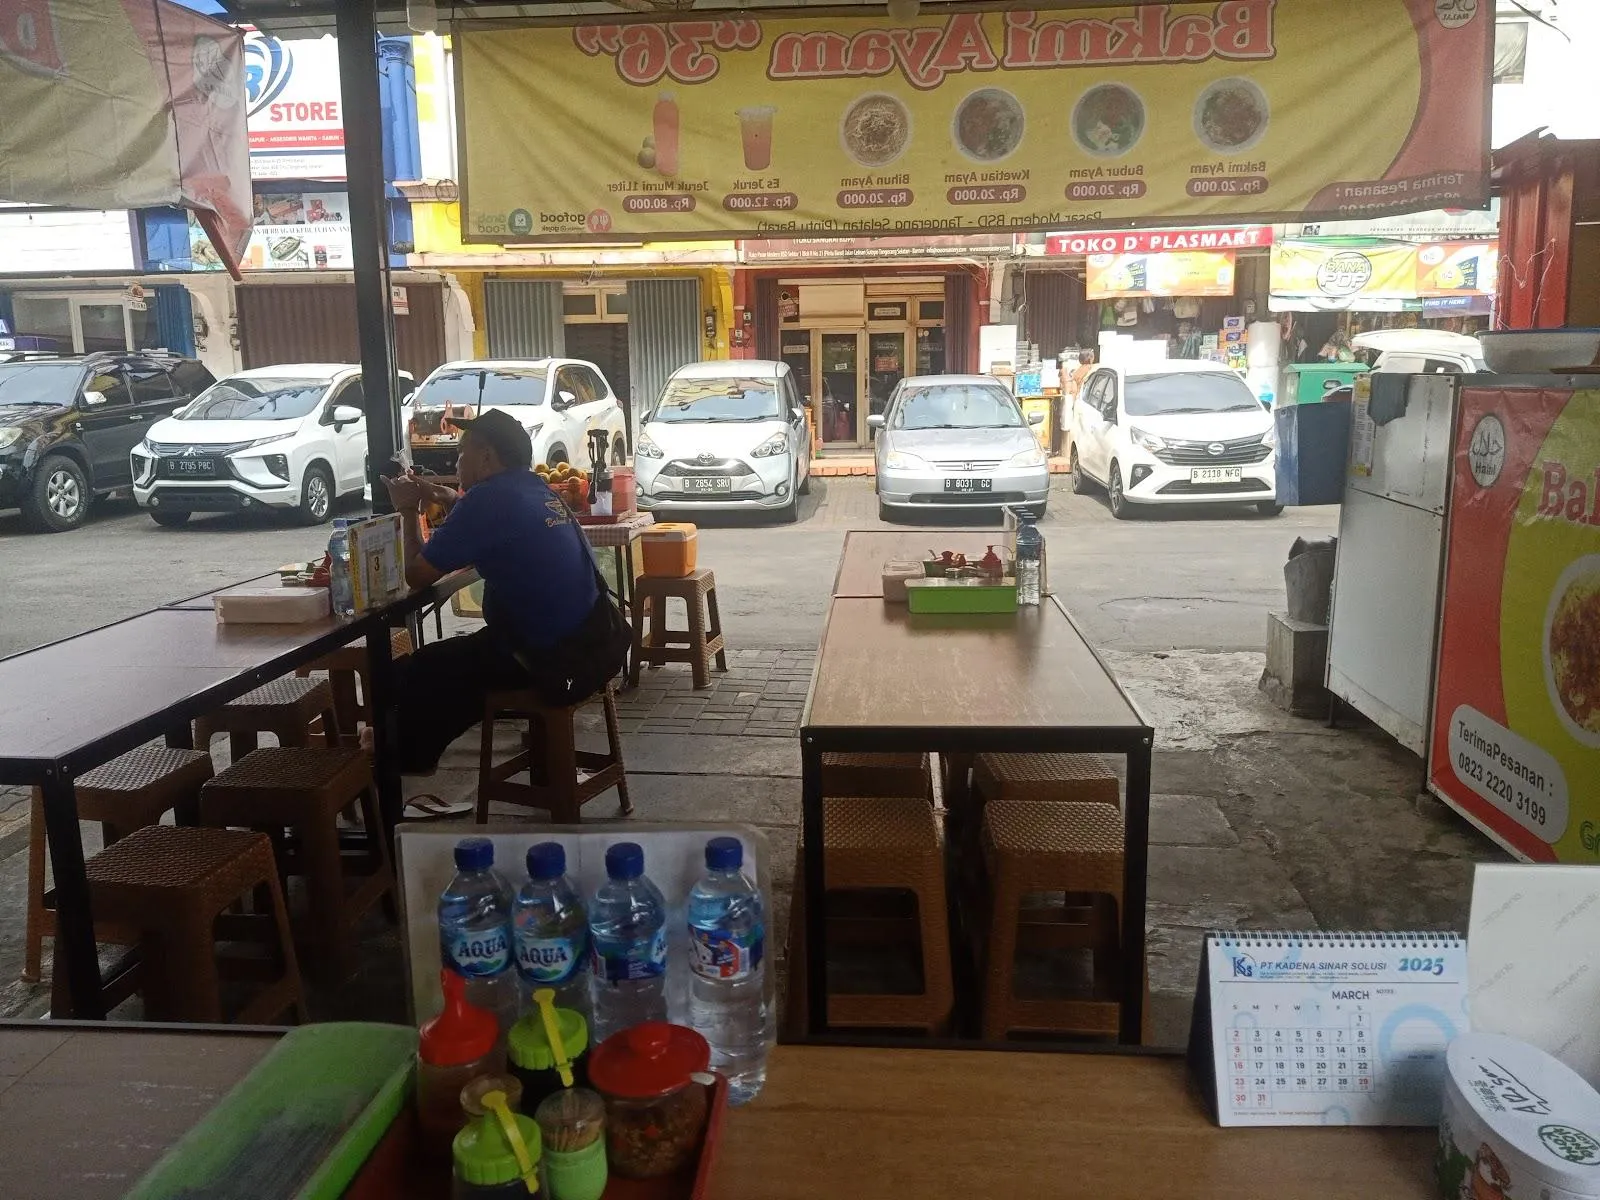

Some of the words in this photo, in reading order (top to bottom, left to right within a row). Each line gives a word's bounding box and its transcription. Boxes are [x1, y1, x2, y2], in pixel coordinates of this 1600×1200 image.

[270, 102, 338, 122] STORE
[1059, 237, 1117, 253] TOKO
[1151, 231, 1260, 249] PLASMART
[169, 461, 175, 470] B
[1193, 470, 1198, 479] B
[1225, 468, 1240, 477] NFG
[685, 479, 690, 488] B
[695, 478, 713, 488] 2654
[945, 479, 951, 488] B
[955, 479, 973, 488] 8031
[374, 556, 380, 571] 3
[1458, 752, 1483, 782] 0823
[1486, 771, 1513, 803] 2220
[1516, 791, 1546, 826] 3199
[459, 935, 508, 958] AQUA
[519, 946, 568, 966] AQUA
[1260, 962, 1272, 970] PT
[1275, 962, 1316, 970] KADENA
[1318, 962, 1348, 970] SINAR
[1350, 962, 1387, 970] SOLUSI
[1399, 957, 1444, 976] 2025
[1332, 991, 1370, 1000] MARCH
